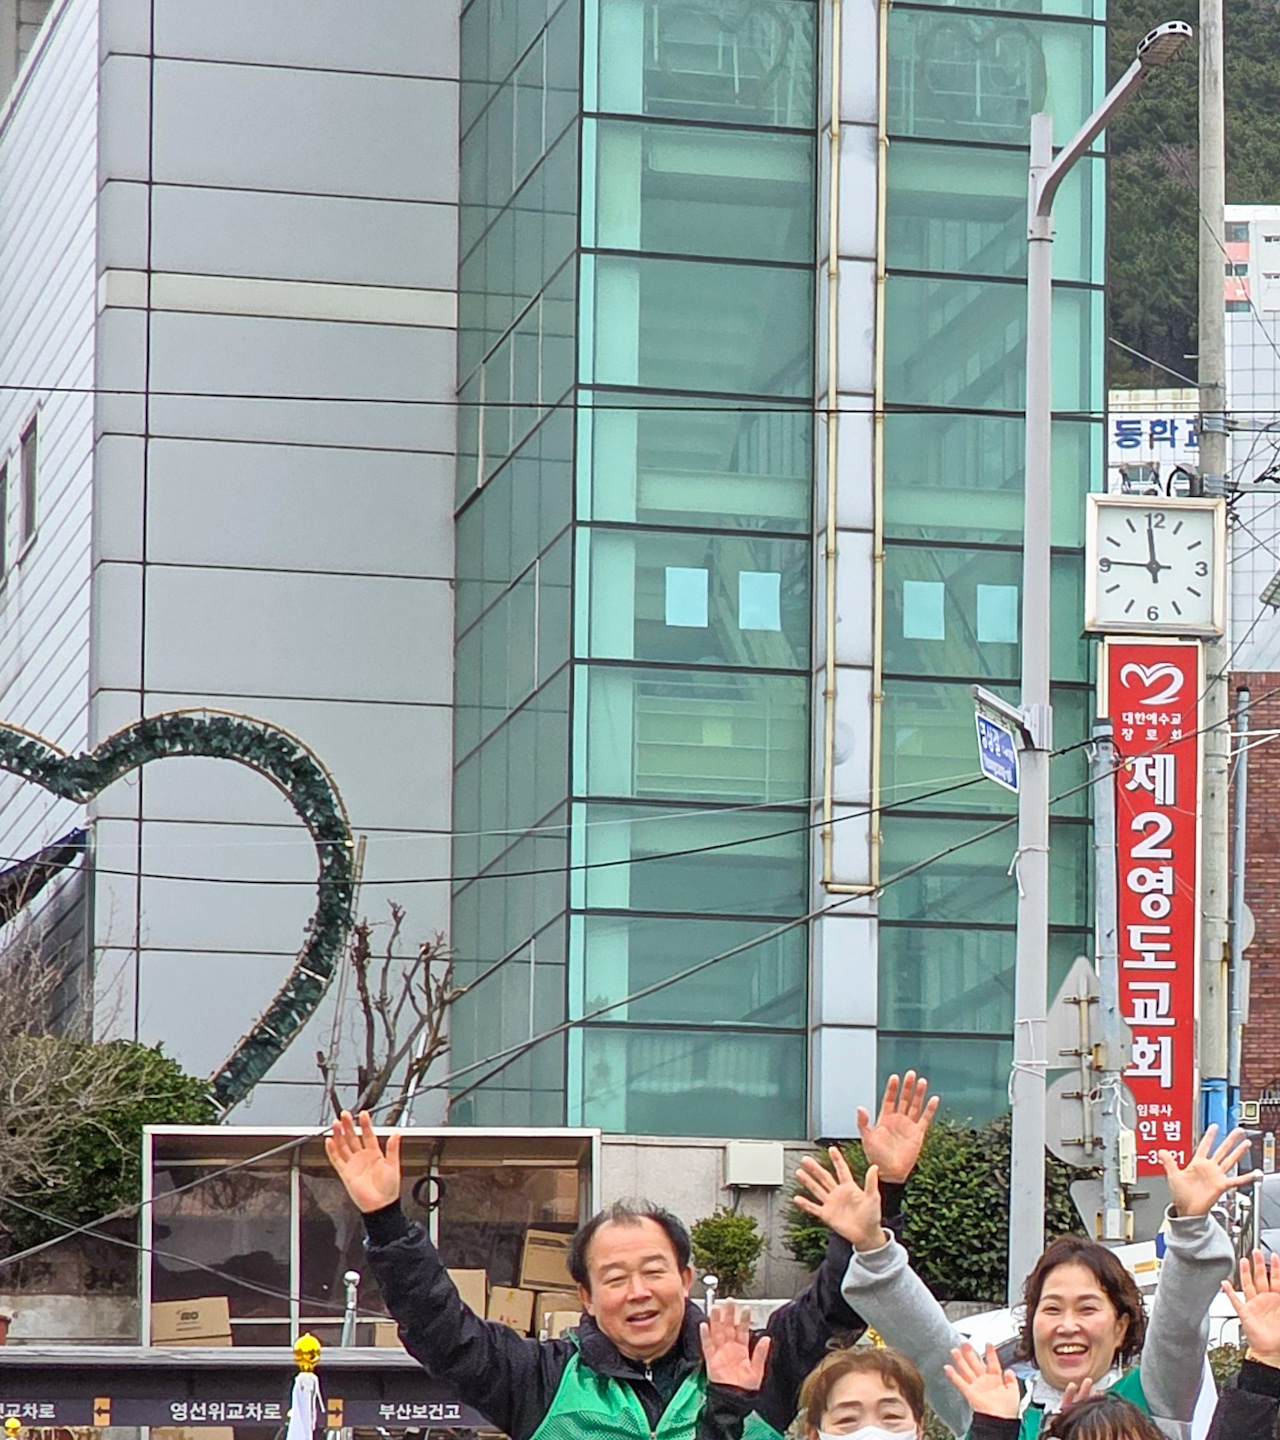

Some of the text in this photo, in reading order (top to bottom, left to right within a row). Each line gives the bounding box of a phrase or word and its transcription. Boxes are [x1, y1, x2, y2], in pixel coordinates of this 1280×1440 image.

[1143, 512, 1166, 529] 12
[1195, 561, 1208, 577] 3
[1147, 605, 1159, 621] 6
[1122, 712, 1182, 726] 대한예수교
[169, 1402, 283, 1421] 영선위교차로
[379, 1404, 461, 1420] 부산보건고
